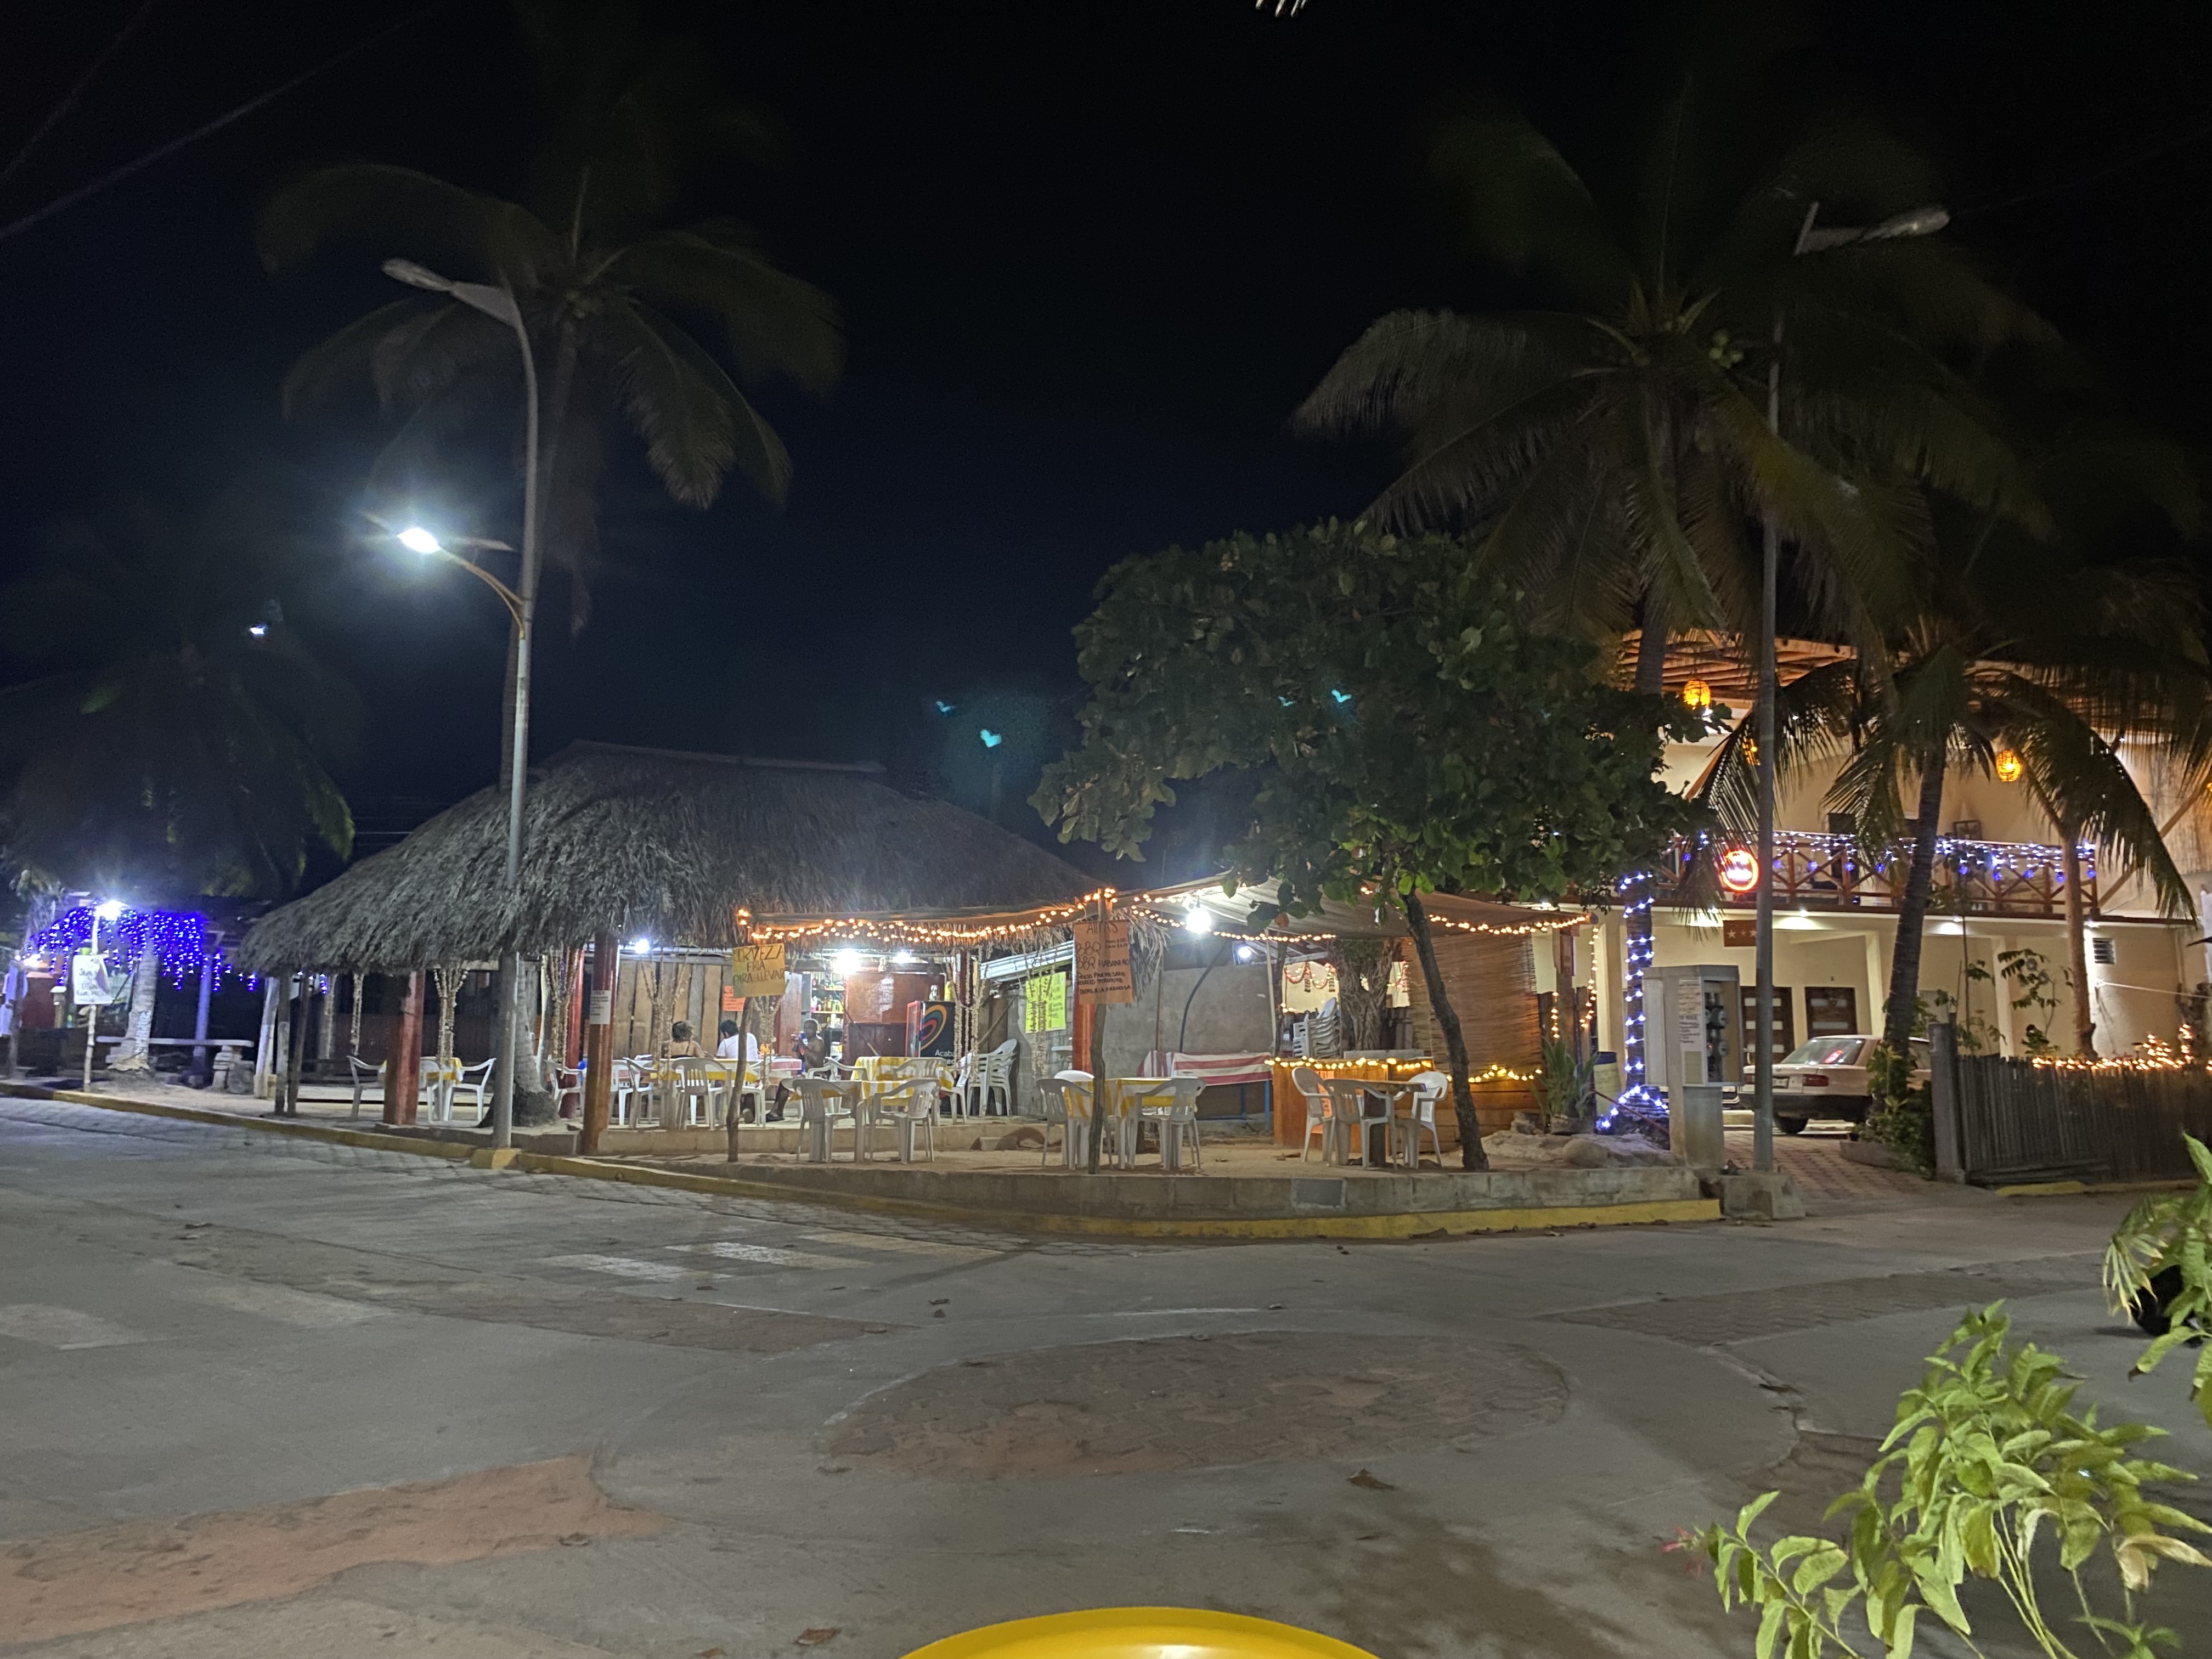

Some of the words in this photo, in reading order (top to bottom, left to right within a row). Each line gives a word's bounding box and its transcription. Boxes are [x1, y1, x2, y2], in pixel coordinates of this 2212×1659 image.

[733, 945, 783, 962] CERVEZA
[1076, 941, 1101, 956] BBQ
[747, 960, 765, 972] FRIA
[1076, 956, 1096, 970] BBQ
[1098, 959, 1130, 967] HABANERO
[733, 973, 753, 985] PARA
[757, 968, 785, 981] LLEVAR
